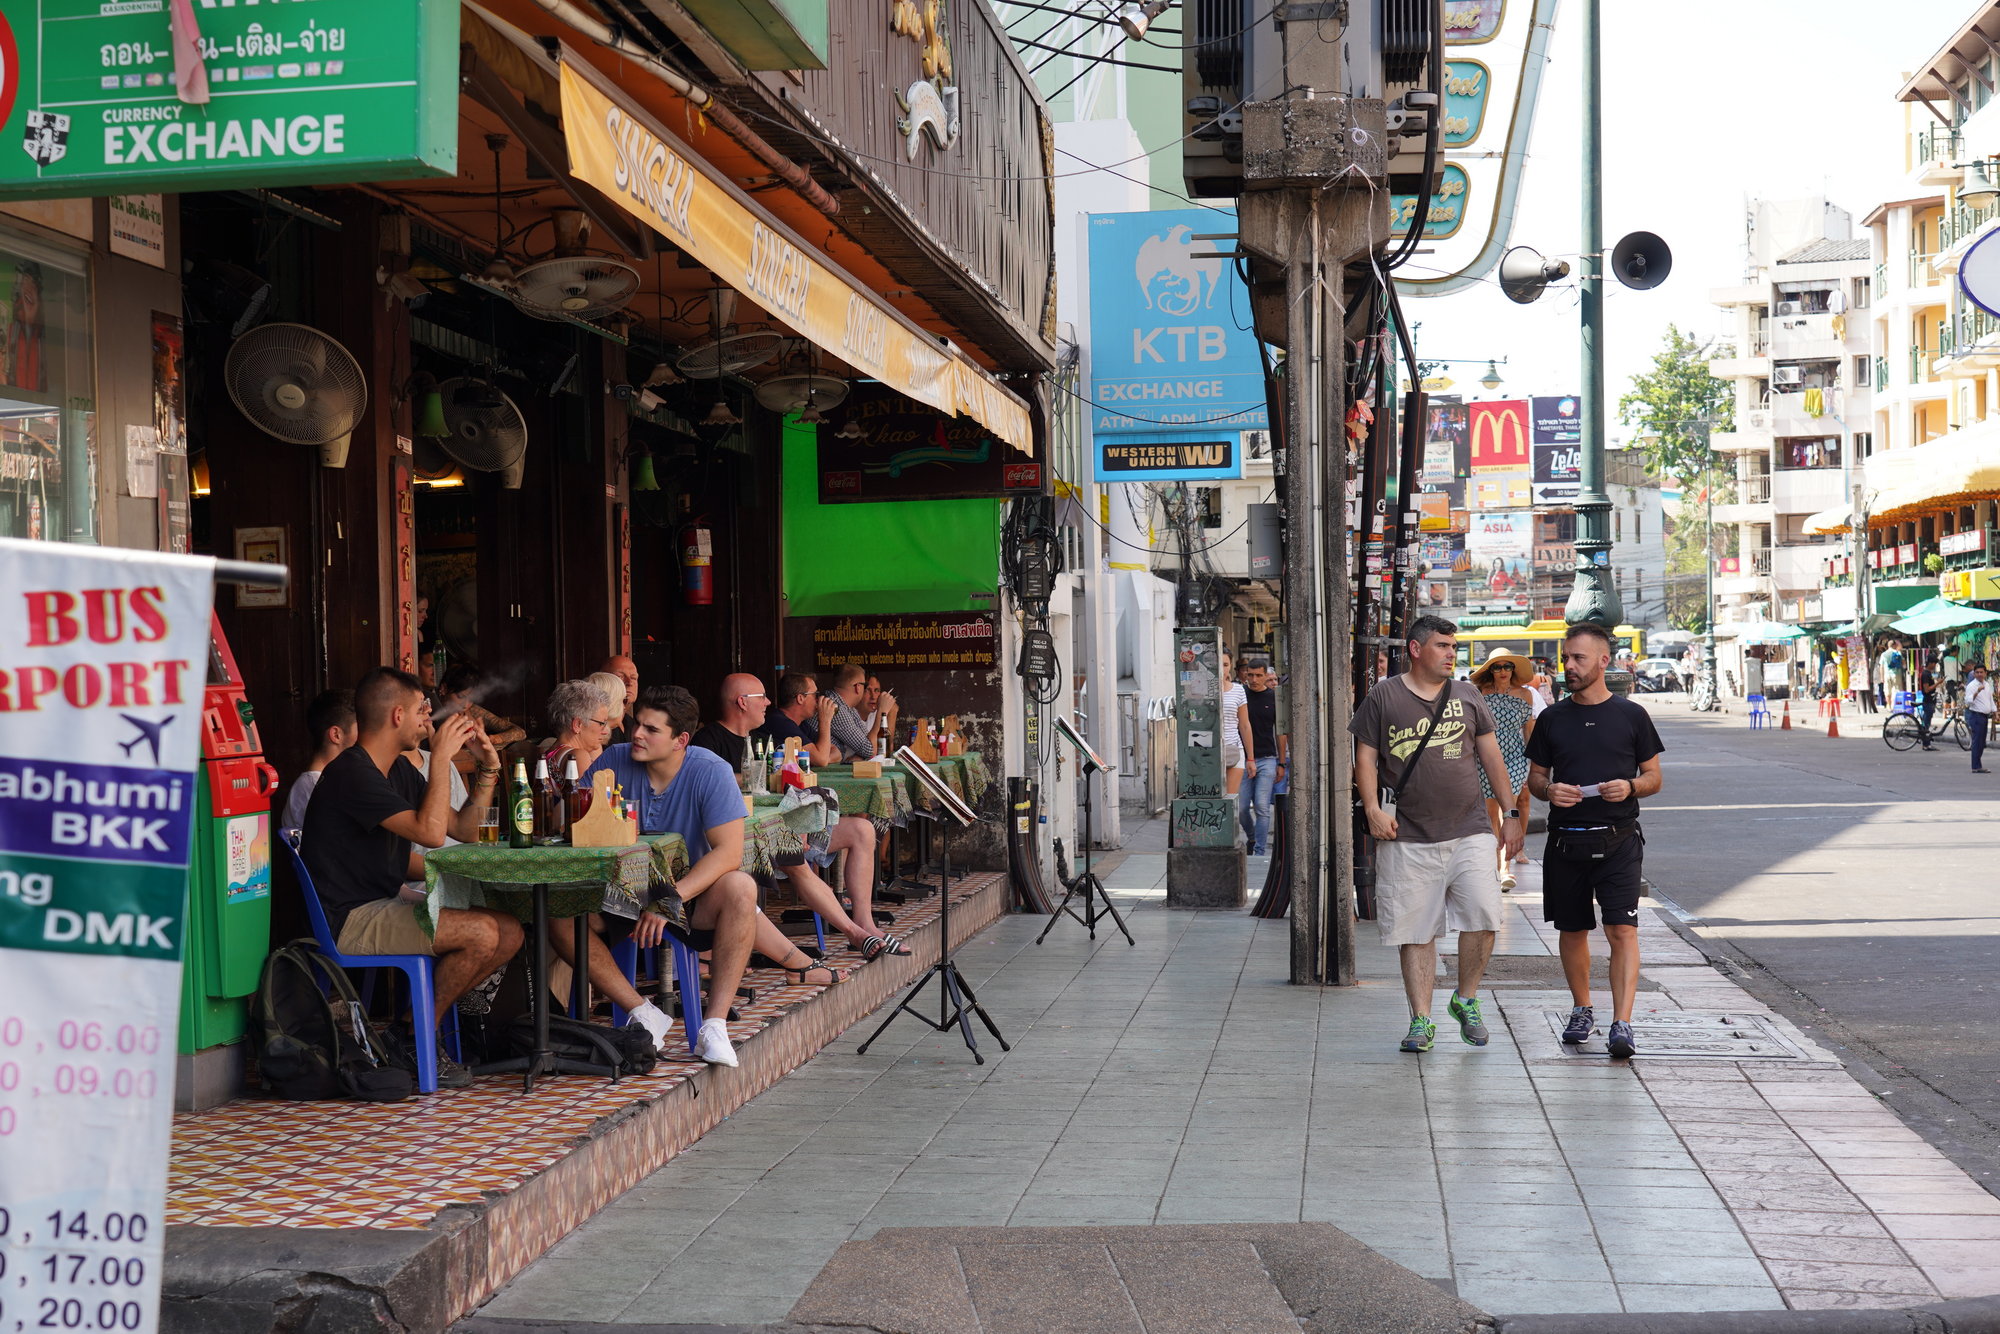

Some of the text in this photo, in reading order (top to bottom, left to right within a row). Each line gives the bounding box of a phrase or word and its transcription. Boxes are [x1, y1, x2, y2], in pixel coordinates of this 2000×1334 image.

[100, 19, 346, 67] ถอน-น-เติม-จ่าย
[102, 105, 183, 124] CURRENCY
[104, 114, 345, 165] EXCHANGE
[606, 106, 696, 248] SINGHA
[745, 221, 811, 327] SINGHA
[843, 291, 887, 370] SINGHA
[1133, 325, 1227, 364] KTB
[1098, 380, 1224, 401] EXCHANGE
[1099, 411, 1268, 429] ATM ADM UPDATE
[1107, 446, 1177, 458] WESTERN
[1129, 457, 1177, 467] UNION
[1483, 523, 1513, 534] ASIA
[23, 586, 168, 648] BUS
[817, 652, 830, 666] This
[830, 654, 846, 668] place
[869, 651, 894, 664] welcome
[895, 651, 905, 663] the
[907, 653, 927, 667] person
[928, 651, 940, 663] who
[960, 650, 974, 663] with
[0, 659, 189, 713] PORT
[1388, 716, 1461, 748] San Dego
[51, 810, 170, 852] BKK
[43, 907, 174, 950] DMK
[57, 1019, 162, 1056] 06.00
[54, 1063, 158, 1100] 09.00
[47, 1208, 148, 1243] 14.00
[42, 1253, 145, 1287] 17.00
[37, 1297, 142, 1330] 20.00
